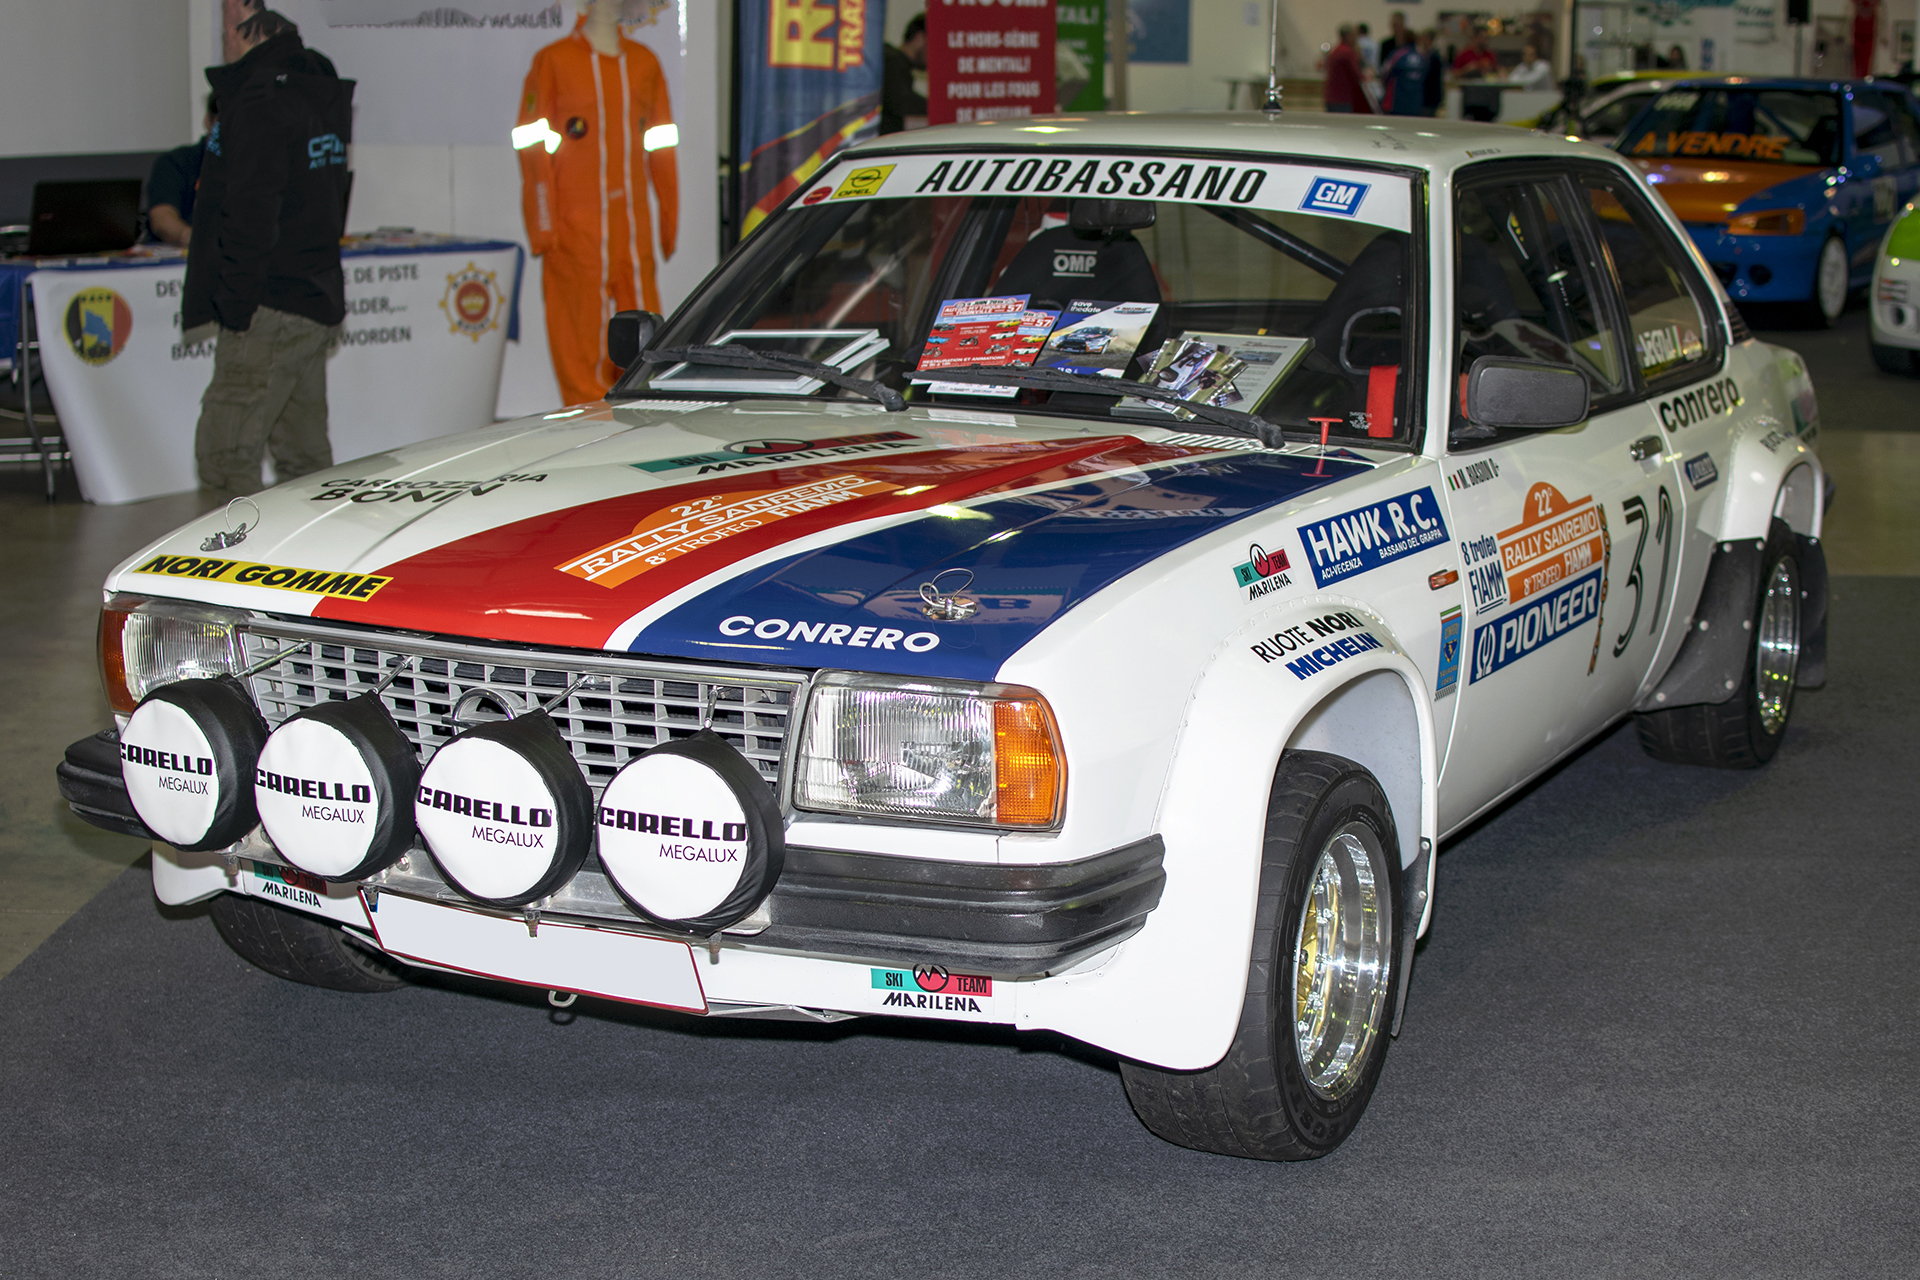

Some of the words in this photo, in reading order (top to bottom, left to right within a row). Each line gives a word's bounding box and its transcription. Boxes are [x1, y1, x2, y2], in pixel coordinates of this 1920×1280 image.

[947, 31, 964, 49] LE
[947, 81, 981, 99] POUR
[983, 81, 1006, 99] LES
[1007, 80, 1040, 98] FOUS
[1632, 131, 1656, 153] A
[1667, 131, 1792, 159] VENDRE
[837, 188, 872, 197] OPEL
[915, 158, 1268, 204] AUTOBASSANO
[1314, 181, 1362, 205] GM
[354, 267, 375, 284] DE
[378, 263, 419, 282] PISTE
[1053, 251, 1098, 275] OMP
[1006, 303, 1023, 312] 57
[1034, 318, 1052, 328] 57
[1658, 376, 1741, 433] conrero
[668, 454, 720, 467] SKI
[826, 431, 904, 446] TEAM
[696, 441, 924, 476] MARILENA
[320, 473, 549, 490] CARROZZRIA
[580, 521, 697, 576] RALLY
[698, 475, 867, 526] SANREMO
[666, 518, 763, 554] TROFEO
[765, 489, 865, 518] FIAMM
[1306, 507, 1391, 567] HAWK
[1386, 493, 1438, 539] R.C.
[1378, 539, 1408, 559] BASSANO
[1407, 537, 1421, 549] DEL
[1419, 528, 1443, 545] GRAPPA
[1460, 541, 1471, 566] 8
[1468, 534, 1498, 563] trofeo
[1504, 533, 1542, 569] RALLY
[1543, 510, 1597, 551] SANREMO
[139, 555, 235, 579] NORI
[233, 564, 385, 599] GOMME
[1530, 563, 1562, 592] TROFEO
[1563, 541, 1593, 576] FIAMM
[1612, 484, 1673, 659] 31
[1248, 572, 1293, 601] MARILENA
[1468, 559, 1507, 608] FIAMM
[718, 615, 940, 653] CONRERO
[1498, 575, 1599, 664] PIONEER
[1249, 624, 1314, 664] RUOTE
[1305, 610, 1365, 638] NORI
[1284, 632, 1384, 681] MICHELIN
[120, 741, 213, 777] CARELLO
[158, 775, 210, 796] MEGALUX
[255, 768, 371, 804] CARELLO
[301, 805, 366, 825] MEGALUX
[417, 785, 553, 828] CARELLO
[471, 825, 545, 849] MEGALUX
[600, 806, 747, 842] CARELLO
[658, 842, 739, 864] MEGALUX
[262, 881, 323, 909] MARILENA
[885, 971, 904, 988] SKI
[956, 977, 988, 994] TEAM
[881, 991, 983, 1014] MARILENA
